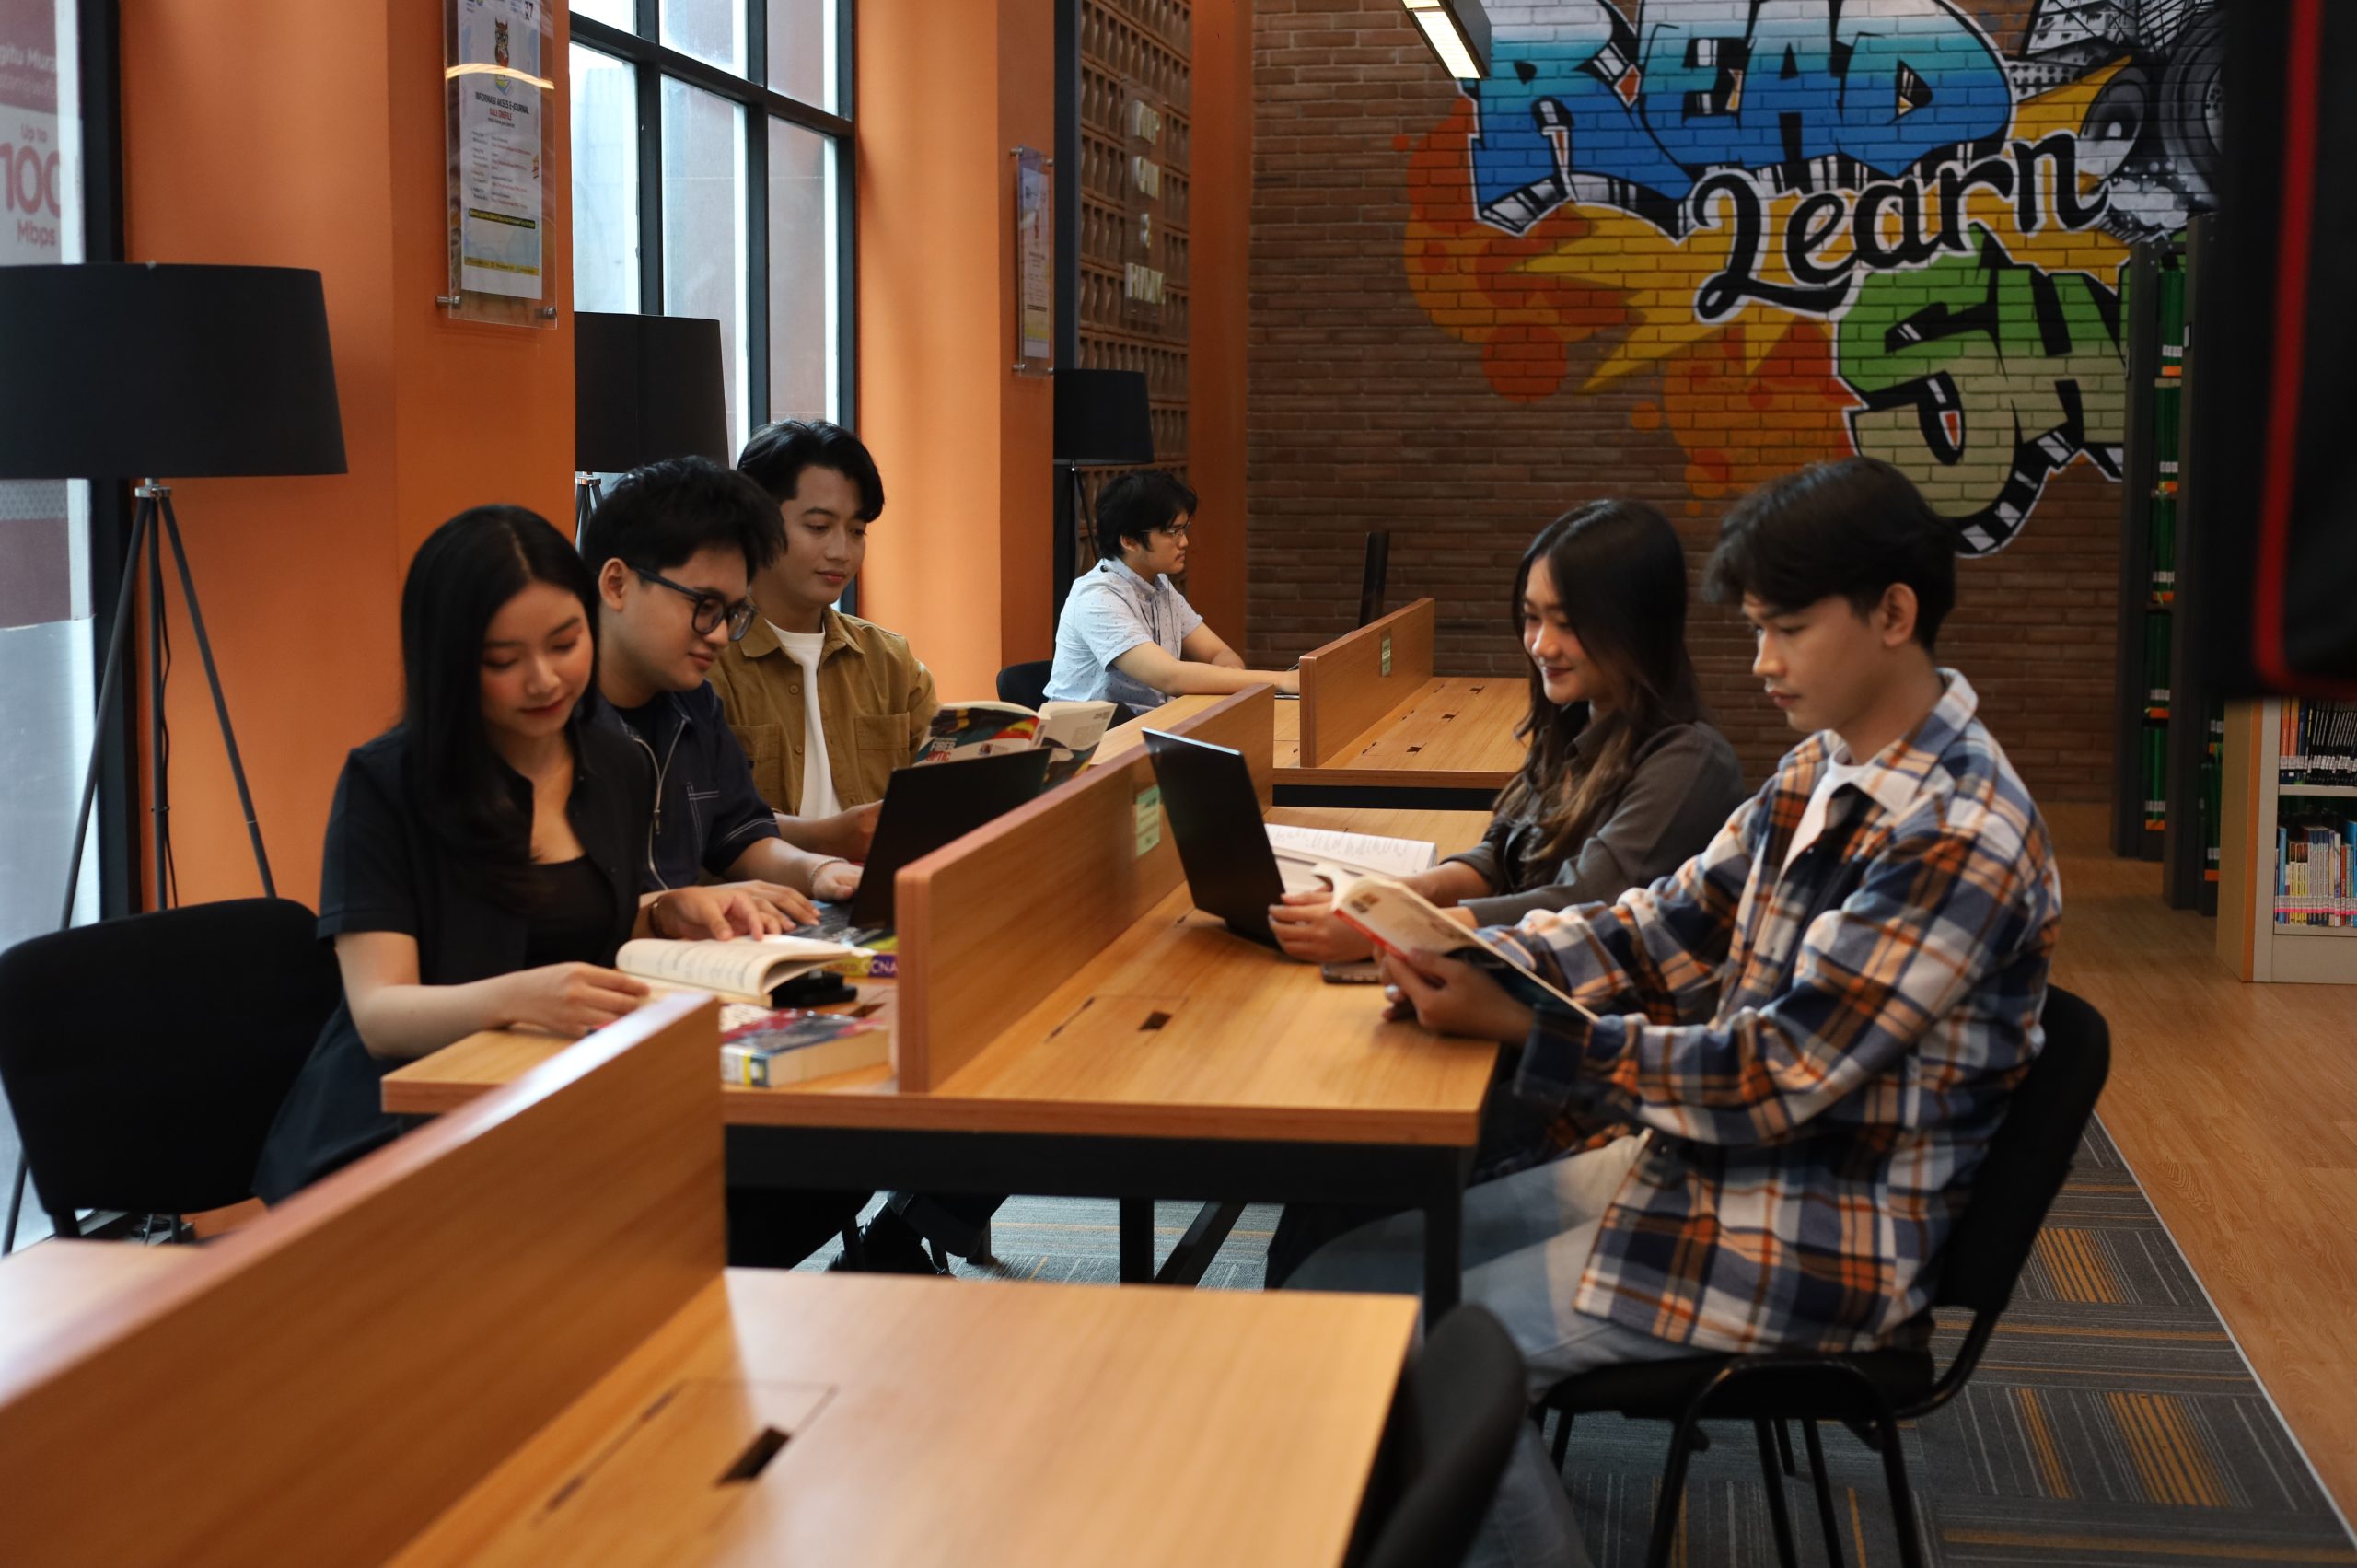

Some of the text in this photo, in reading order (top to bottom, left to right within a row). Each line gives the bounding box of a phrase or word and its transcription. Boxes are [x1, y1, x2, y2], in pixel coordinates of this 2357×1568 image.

[1470, 0, 2016, 230] READ
[20, 122, 48, 143] Up to
[17, 220, 56, 249] Mbps
[1696, 131, 2111, 320] Learn
[926, 750, 952, 762] OPTIC
[930, 741, 957, 752] FIBER
[860, 959, 899, 974] CCNA
